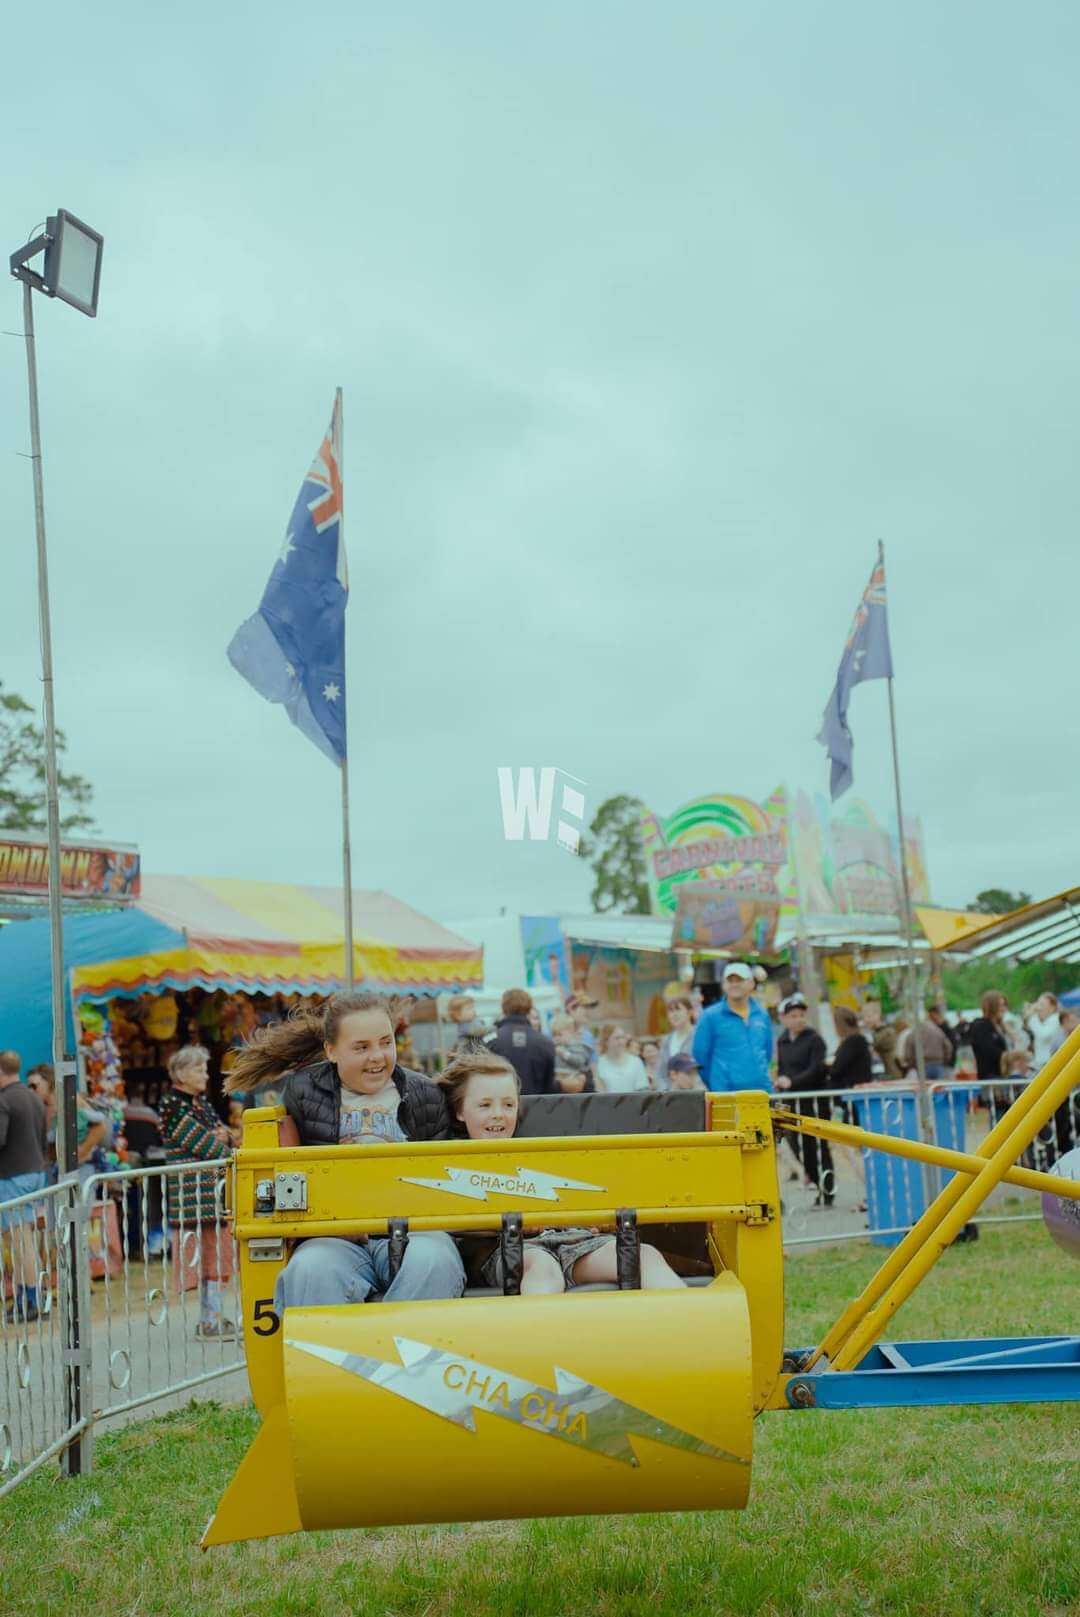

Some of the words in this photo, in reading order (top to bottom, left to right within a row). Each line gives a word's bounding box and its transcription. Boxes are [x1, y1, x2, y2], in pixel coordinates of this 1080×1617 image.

[253, 1298, 280, 1337] 5
[443, 1363, 510, 1409] CHA
[519, 1391, 588, 1441] CHA
